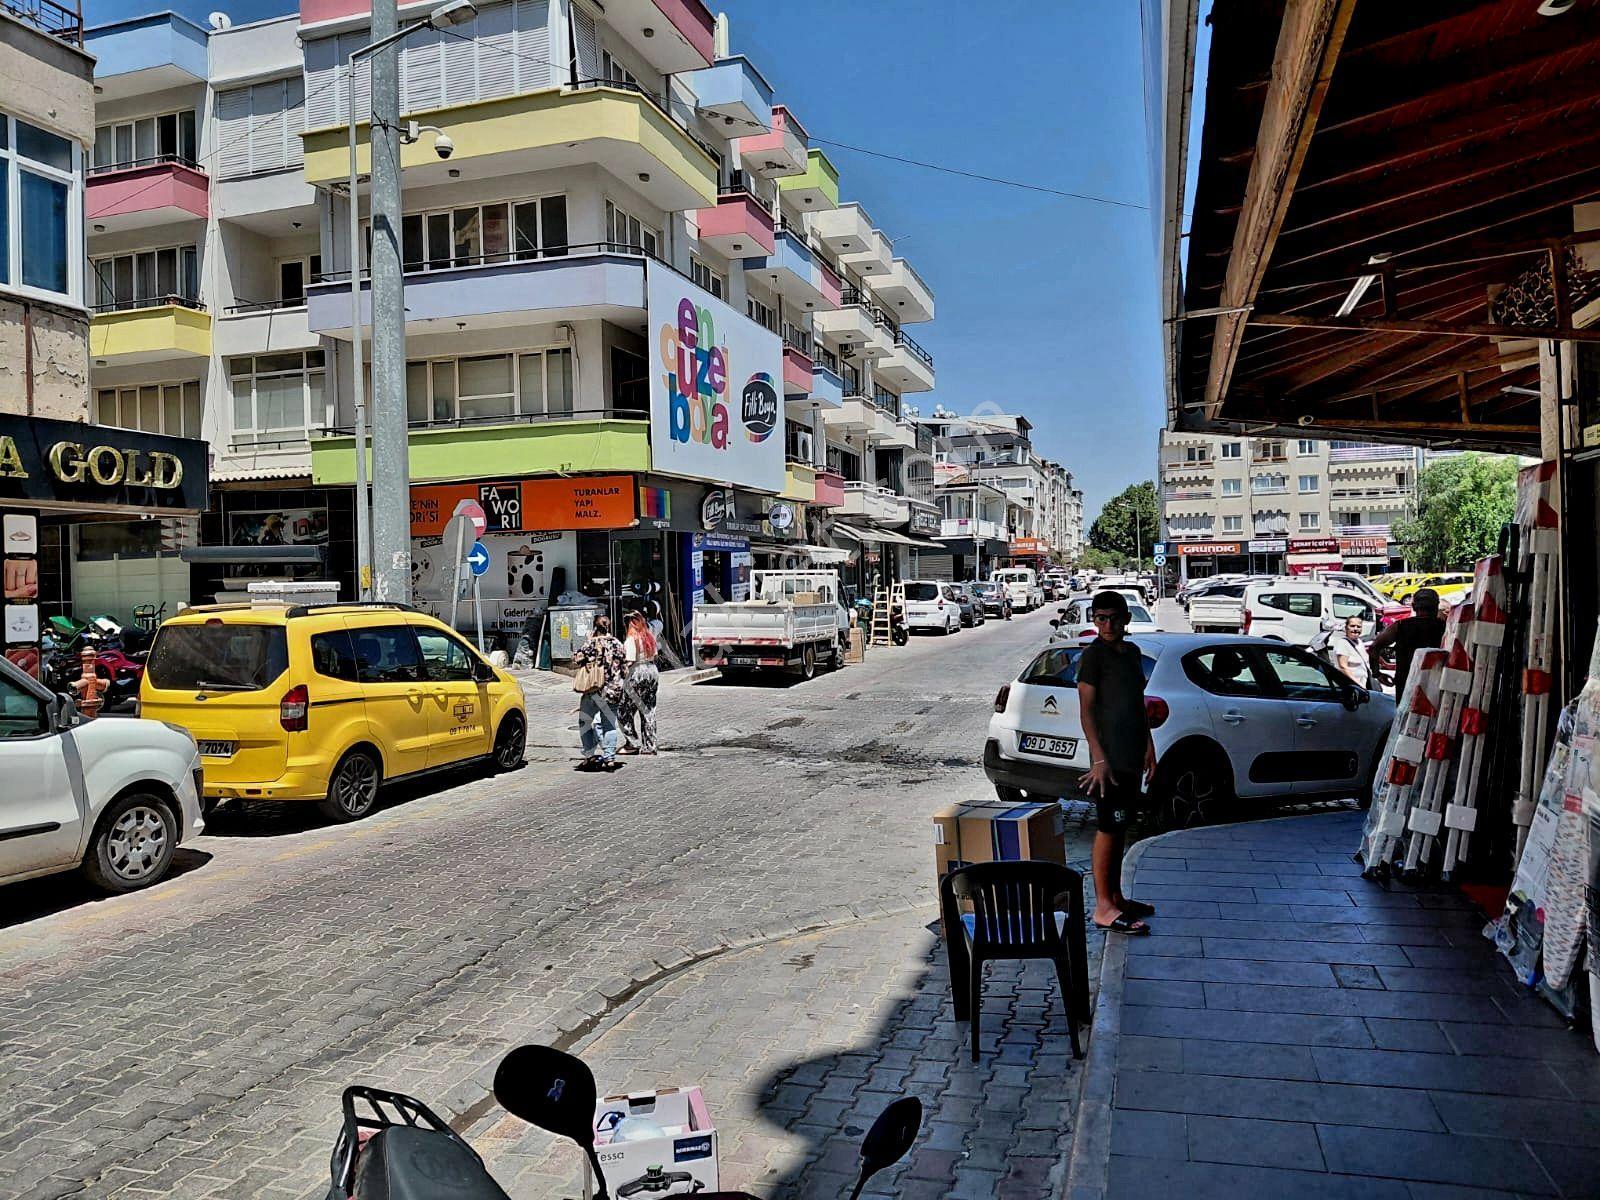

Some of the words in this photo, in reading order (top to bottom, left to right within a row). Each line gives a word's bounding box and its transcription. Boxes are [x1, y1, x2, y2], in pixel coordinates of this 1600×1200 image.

[744, 390, 758, 417] Filli
[758, 391, 776, 423] Boya
[48, 440, 184, 489] GOLD
[573, 487, 620, 497] TURANLAR
[574, 499, 593, 507] YAPI
[575, 510, 602, 518] MALZ.
[1183, 545, 1236, 553] GRUNDIG
[1025, 736, 1037, 748] 09
[1038, 738, 1047, 750] D
[1049, 740, 1074, 754] 3657
